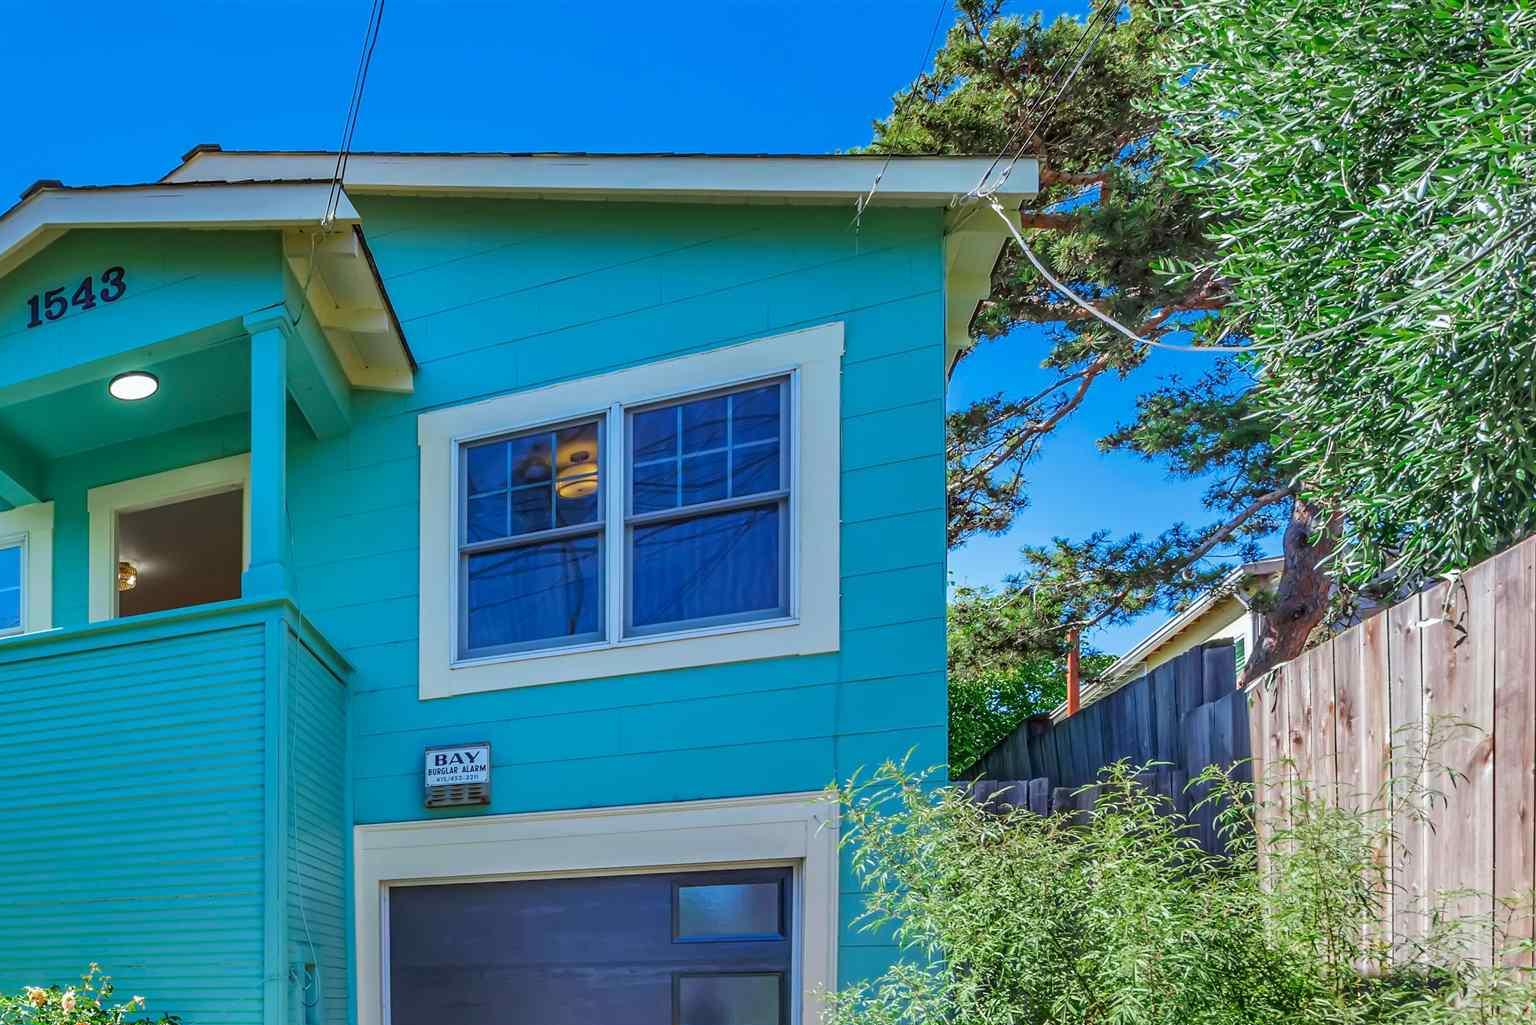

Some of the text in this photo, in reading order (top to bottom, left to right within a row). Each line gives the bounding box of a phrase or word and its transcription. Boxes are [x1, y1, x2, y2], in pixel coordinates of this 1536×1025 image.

[27, 266, 126, 328] 1543
[435, 751, 480, 767] BAY
[428, 764, 486, 776] BURGLAR ALARM
